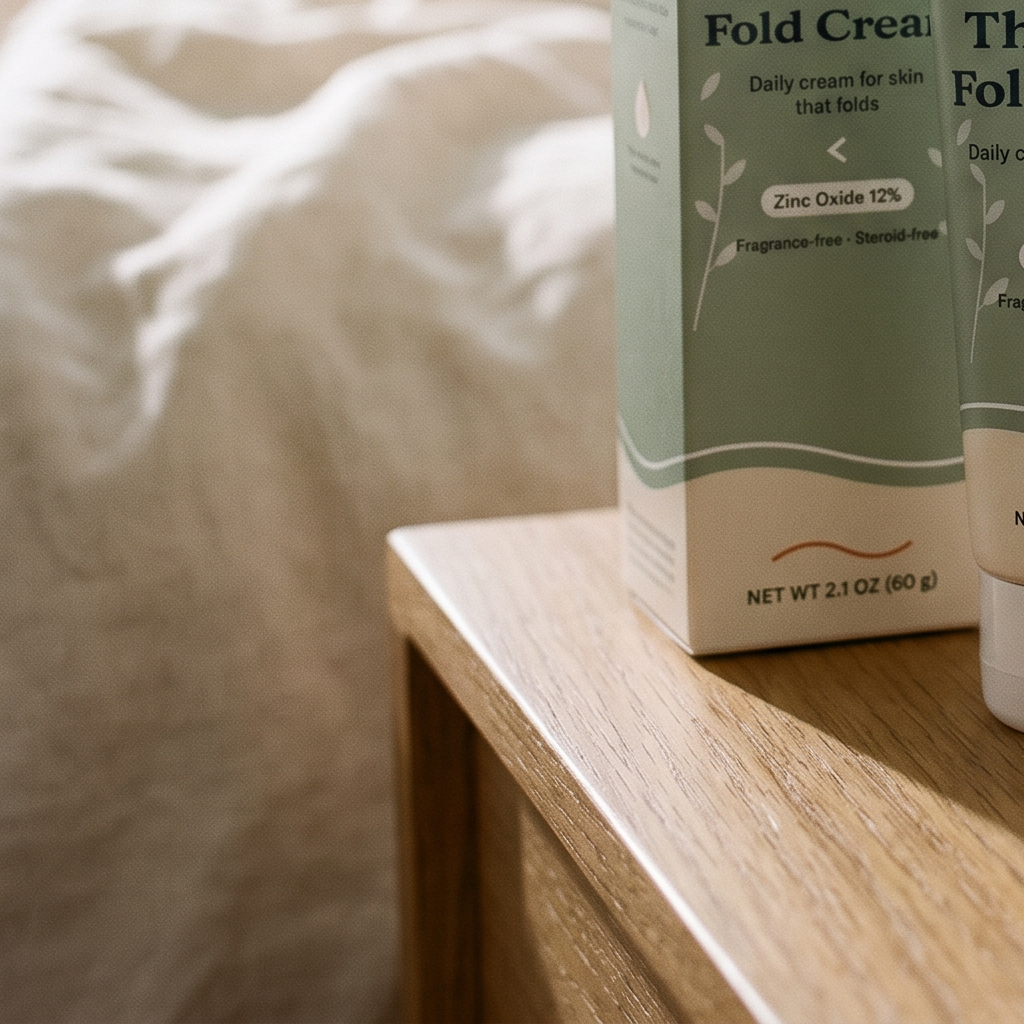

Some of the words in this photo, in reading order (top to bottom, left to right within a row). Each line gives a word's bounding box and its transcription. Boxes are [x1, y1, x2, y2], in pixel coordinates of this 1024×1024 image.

[704, 9, 804, 47] Fold
[815, 8, 932, 43] Crea
[749, 74, 795, 96] Daily
[798, 75, 855, 91] cream
[859, 69, 884, 88] for
[888, 68, 924, 87] skin
[795, 98, 833, 115] that
[835, 95, 880, 114] folds
[968, 143, 1011, 166] Daily
[773, 193, 811, 210] Zinc
[815, 189, 865, 208] Oxide
[868, 187, 903, 204] 12%
[736, 233, 844, 255] Fragrance-free
[854, 227, 939, 246] Steroid-free
[746, 586, 786, 606] NET
[789, 582, 821, 602] WT
[824, 580, 849, 599] 2.1
[853, 577, 880, 596] OZ
[884, 573, 917, 596] (60
[919, 570, 938, 594] g)
